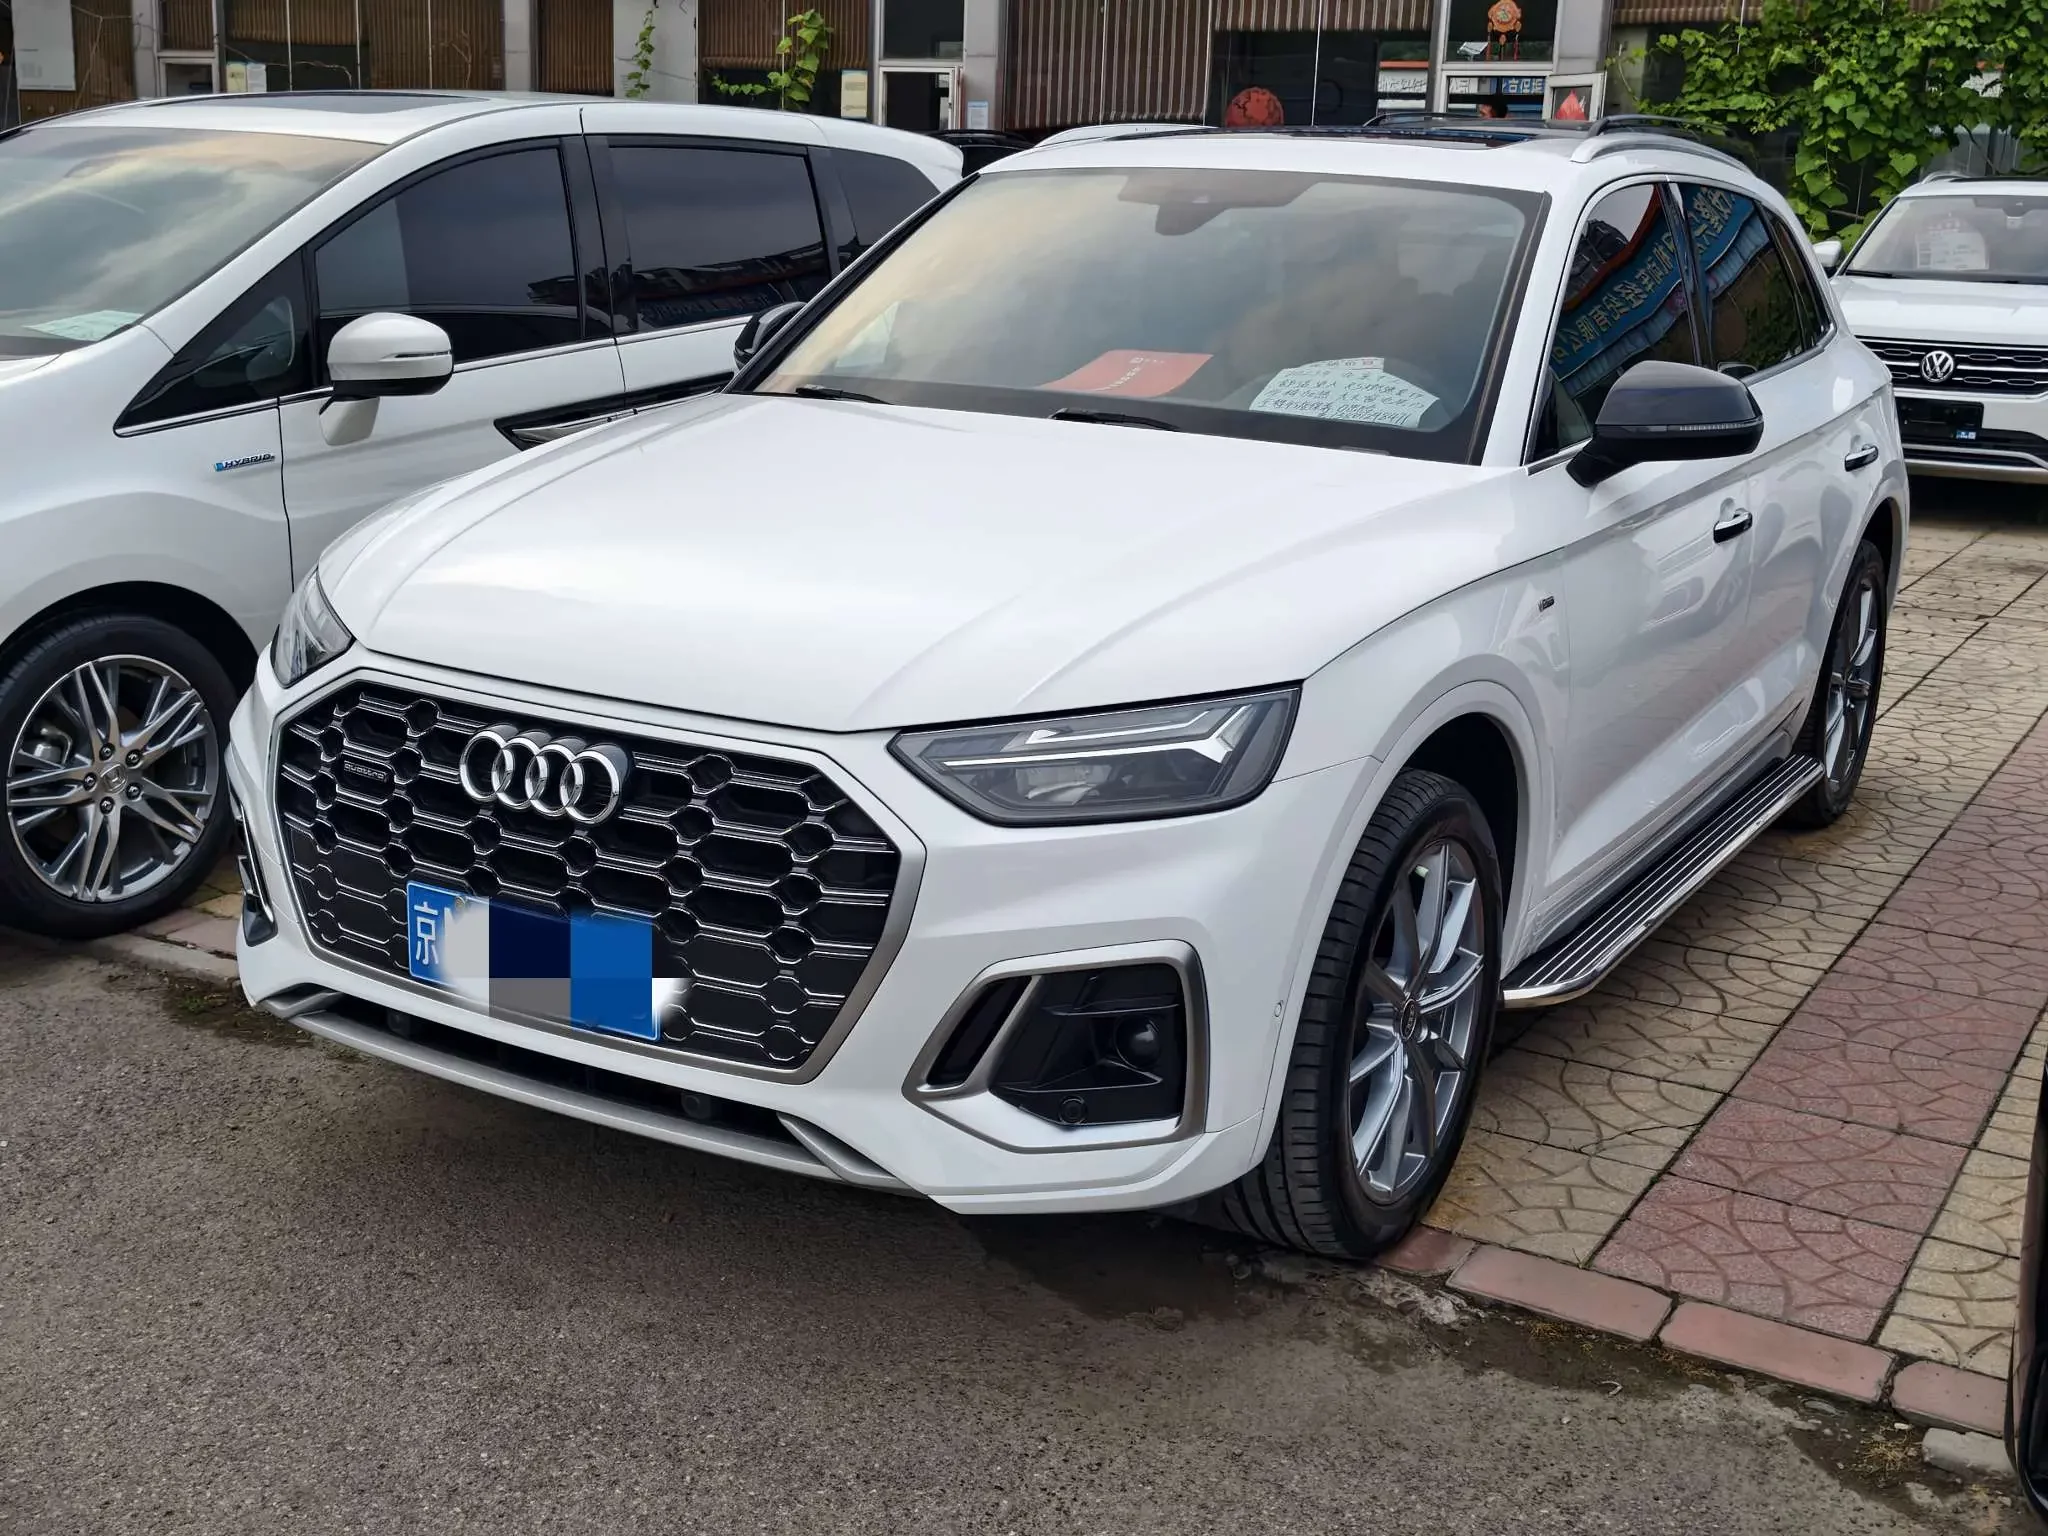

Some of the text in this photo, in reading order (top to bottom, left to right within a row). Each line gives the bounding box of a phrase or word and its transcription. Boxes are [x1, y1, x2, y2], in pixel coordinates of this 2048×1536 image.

[223, 453, 272, 469] HYBRID
[344, 763, 385, 780] quattro
[413, 901, 439, 966] 京
